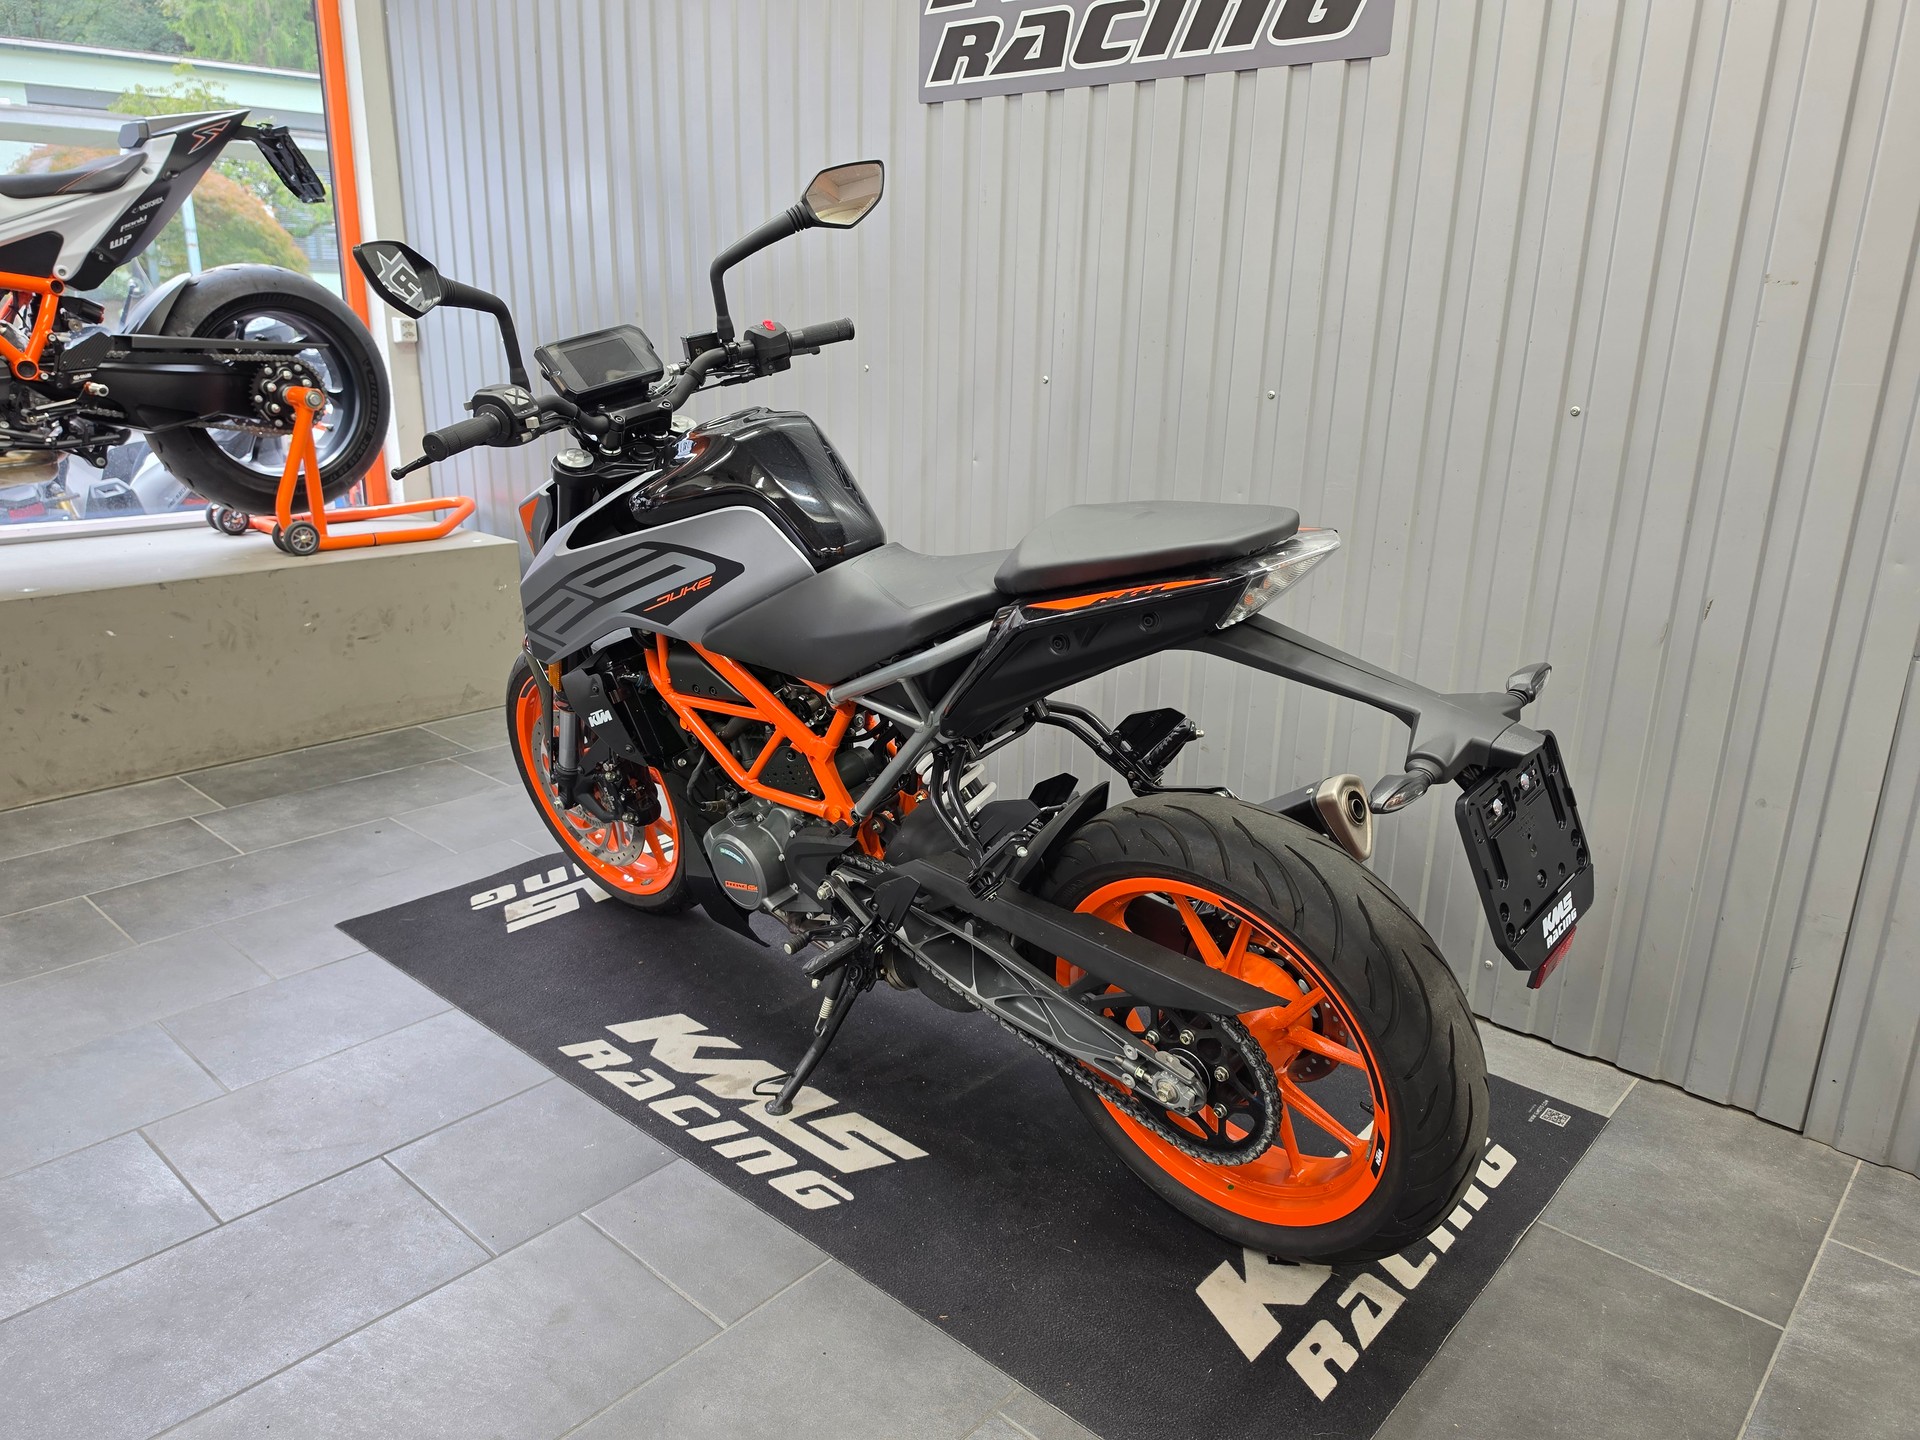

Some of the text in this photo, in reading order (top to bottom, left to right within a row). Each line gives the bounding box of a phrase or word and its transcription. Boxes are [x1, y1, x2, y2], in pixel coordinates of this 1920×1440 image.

[643, 576, 713, 612] DUKE
[588, 709, 613, 727] KTM
[1542, 891, 1573, 939] KMS
[1546, 908, 1577, 949] RACING
[605, 1013, 930, 1174] KMS
[558, 1040, 855, 1210] RACING
